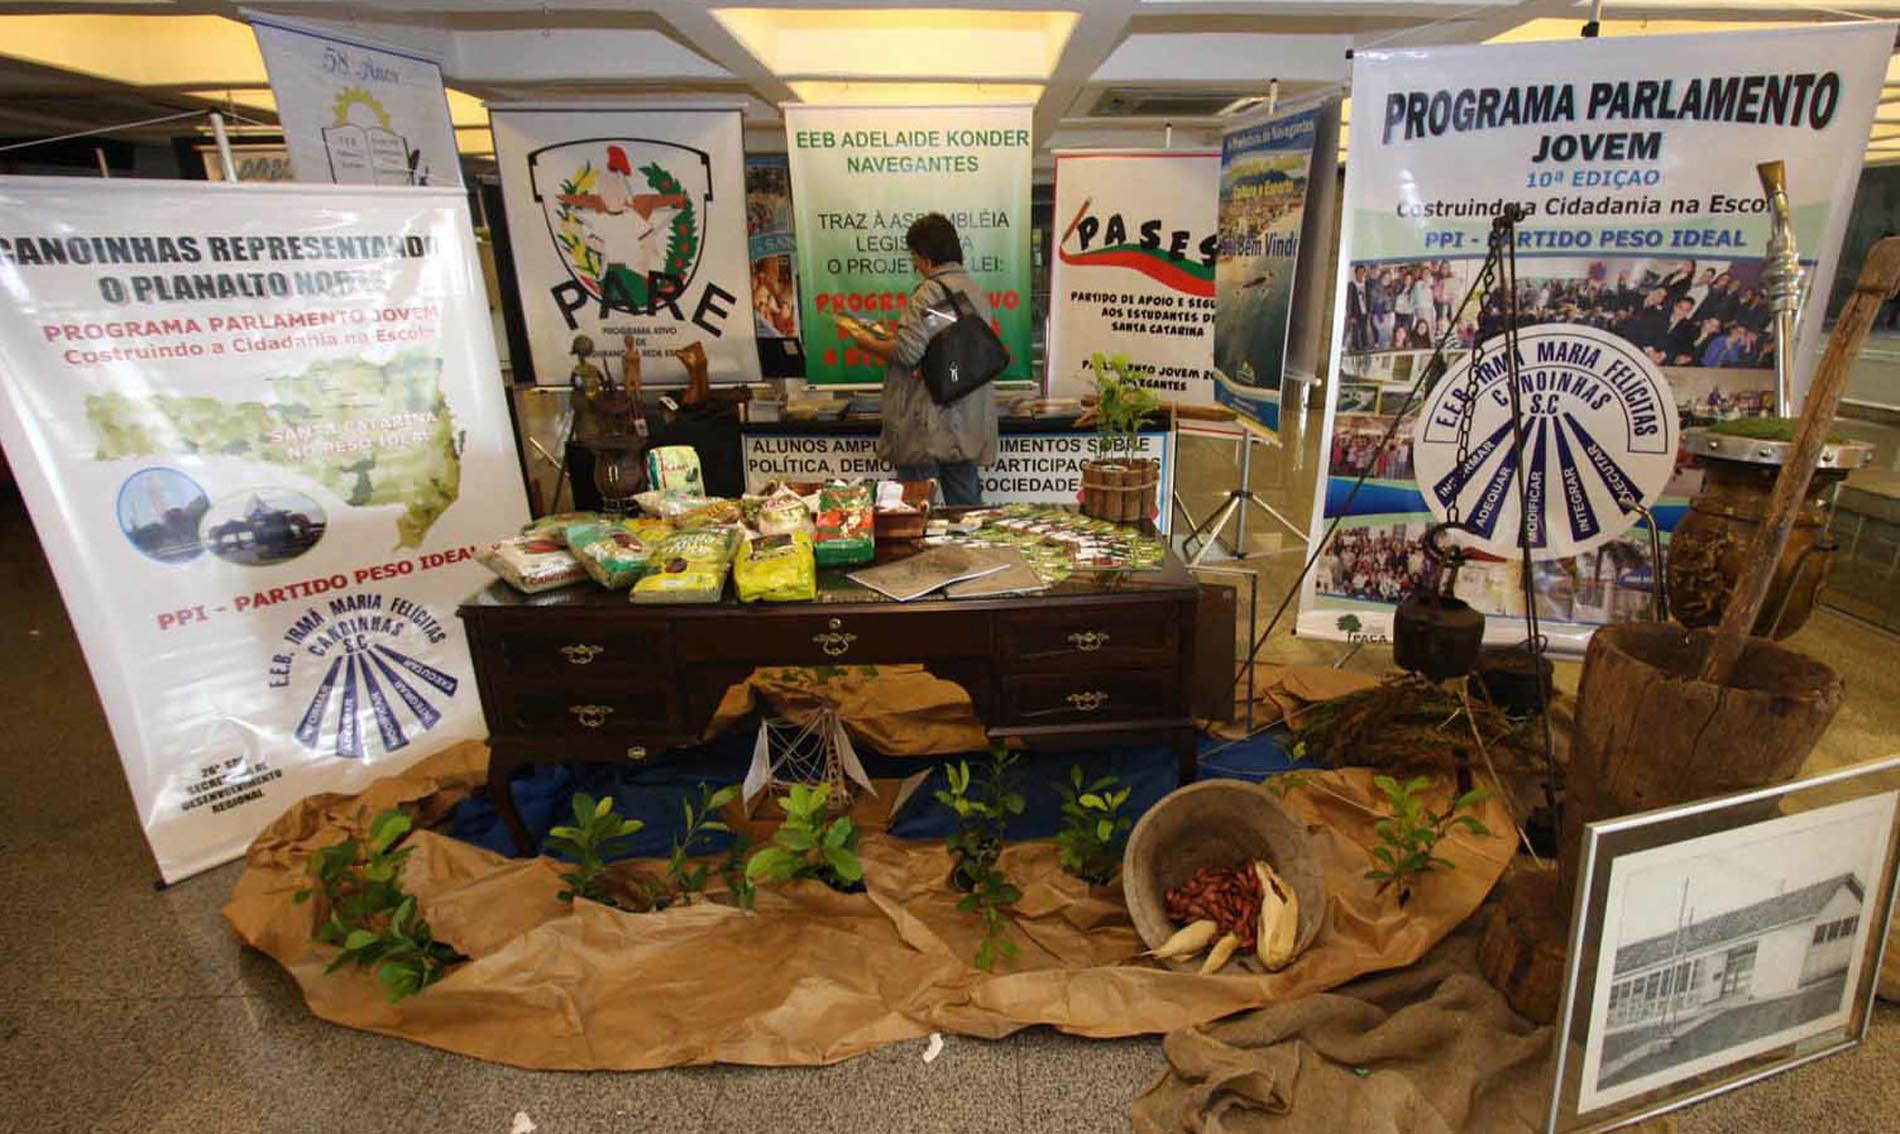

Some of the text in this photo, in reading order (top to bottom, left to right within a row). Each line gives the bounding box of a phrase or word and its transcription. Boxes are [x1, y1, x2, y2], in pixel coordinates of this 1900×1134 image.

[1382, 71, 1841, 145] PROGRAMA PARLAMENTO
[796, 130, 1029, 148] EEB ADELAIDE KONDER
[1532, 132, 1662, 163] JOVEM
[847, 156, 979, 173] NAVEGANTES
[1524, 202, 1537, 216] a
[1545, 196, 1661, 216] Cidadania
[1670, 198, 1700, 214] na
[1709, 194, 1771, 214] Esco
[818, 214, 868, 230] TRAZ
[890, 211, 1010, 230] ASBLÉIA
[857, 234, 974, 252] LEGISA
[1077, 213, 1218, 268] PASES
[1425, 231, 1465, 248] PPI
[1600, 230, 1664, 248] PESO
[1670, 229, 1749, 248] IDEAL
[827, 258, 842, 275] O
[847, 257, 919, 275] PROJE
[98, 275, 126, 303] O
[130, 270, 289, 302] PLANALTO
[551, 269, 737, 339] PARE
[1071, 291, 1118, 304] PARTIDO
[1120, 295, 1134, 305] DE
[1138, 296, 1174, 308] APOIO
[1178, 298, 1184, 308] E
[42, 318, 202, 344] PROGRAMA
[208, 307, 367, 333] PARLAMENTO
[1101, 307, 1124, 318] AOS
[1127, 309, 1199, 323] ESTUDANTES
[1111, 321, 1205, 337] SANTA CATARINA
[63, 339, 207, 366] Costruindo
[211, 342, 225, 355] a
[1159, 366, 1201, 379] JOVEM
[1474, 348, 1525, 385] IRM
[1536, 341, 1602, 369] MARIA
[1602, 358, 1659, 437] FELÍCITAS
[1491, 370, 1613, 411] CNOINHAS
[752, 439, 828, 454] ALUNOS
[1087, 437, 1150, 453] SBE
[749, 456, 836, 475] POLÍTICA,
[1438, 440, 1497, 498] INRMAR
[1475, 466, 1513, 529] ADEQUAR
[1563, 466, 1592, 533] INTEGRAR
[157, 604, 209, 631] PPI
[234, 574, 349, 613] PARTIDO
[354, 560, 414, 585] PESO
[329, 594, 382, 615] MARIA
[307, 615, 404, 657] CANOINHAS
